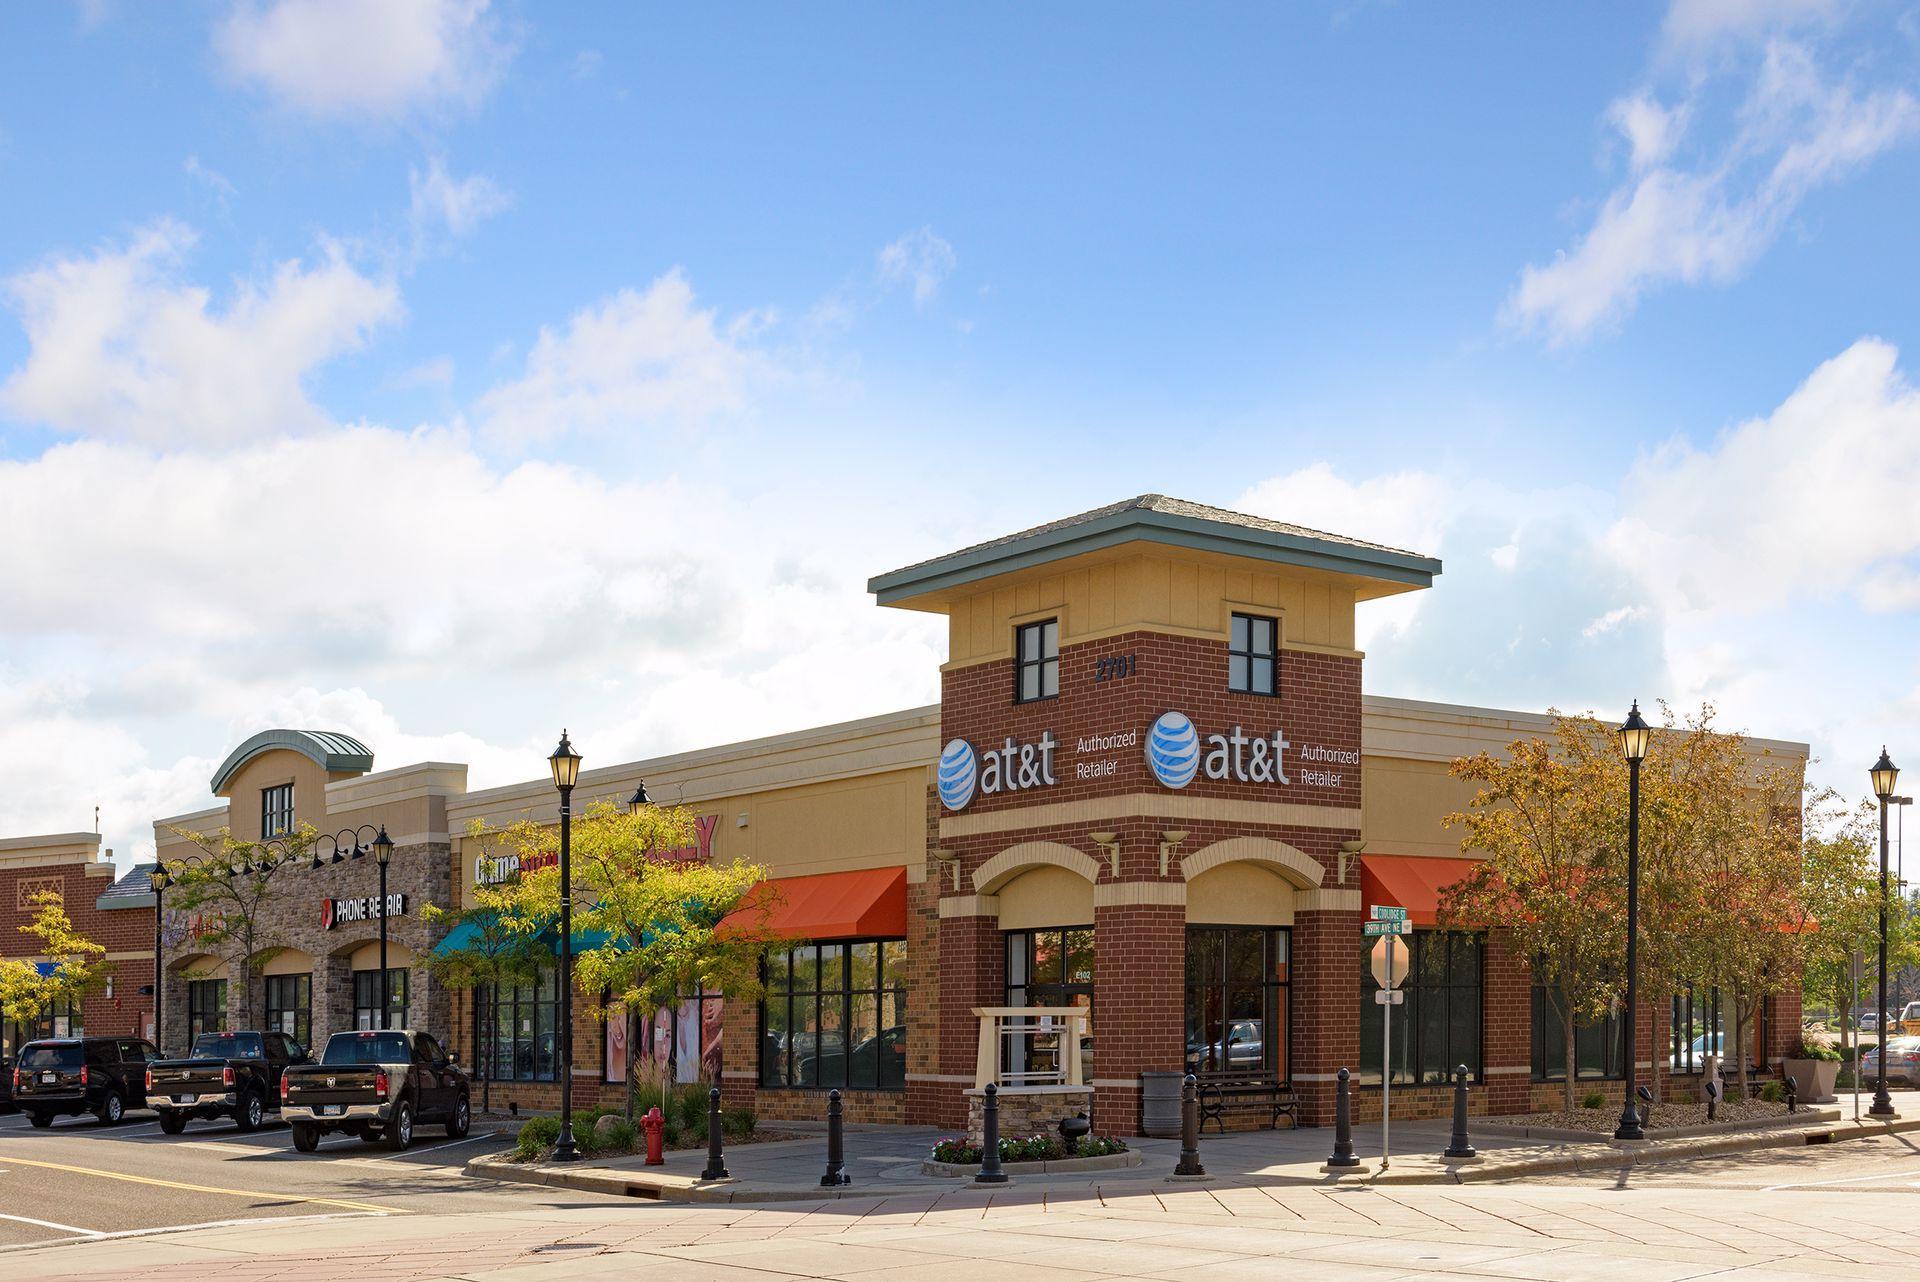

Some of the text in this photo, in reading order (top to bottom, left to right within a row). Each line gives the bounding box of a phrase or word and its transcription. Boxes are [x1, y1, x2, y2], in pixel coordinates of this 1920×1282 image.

[1095, 655, 1136, 682] 2701
[1076, 729, 1136, 753] Authorized
[981, 730, 1057, 794] at&t
[1204, 726, 1290, 785] at&t
[1300, 744, 1360, 765] Authorized
[1076, 759, 1118, 779] Retailer
[1301, 769, 1342, 787] Retailer
[336, 893, 403, 922] PHONE REAIR
[1381, 923, 1391, 933] AVE
[1392, 923, 1400, 932] NE
[1075, 970, 1091, 980] E102
